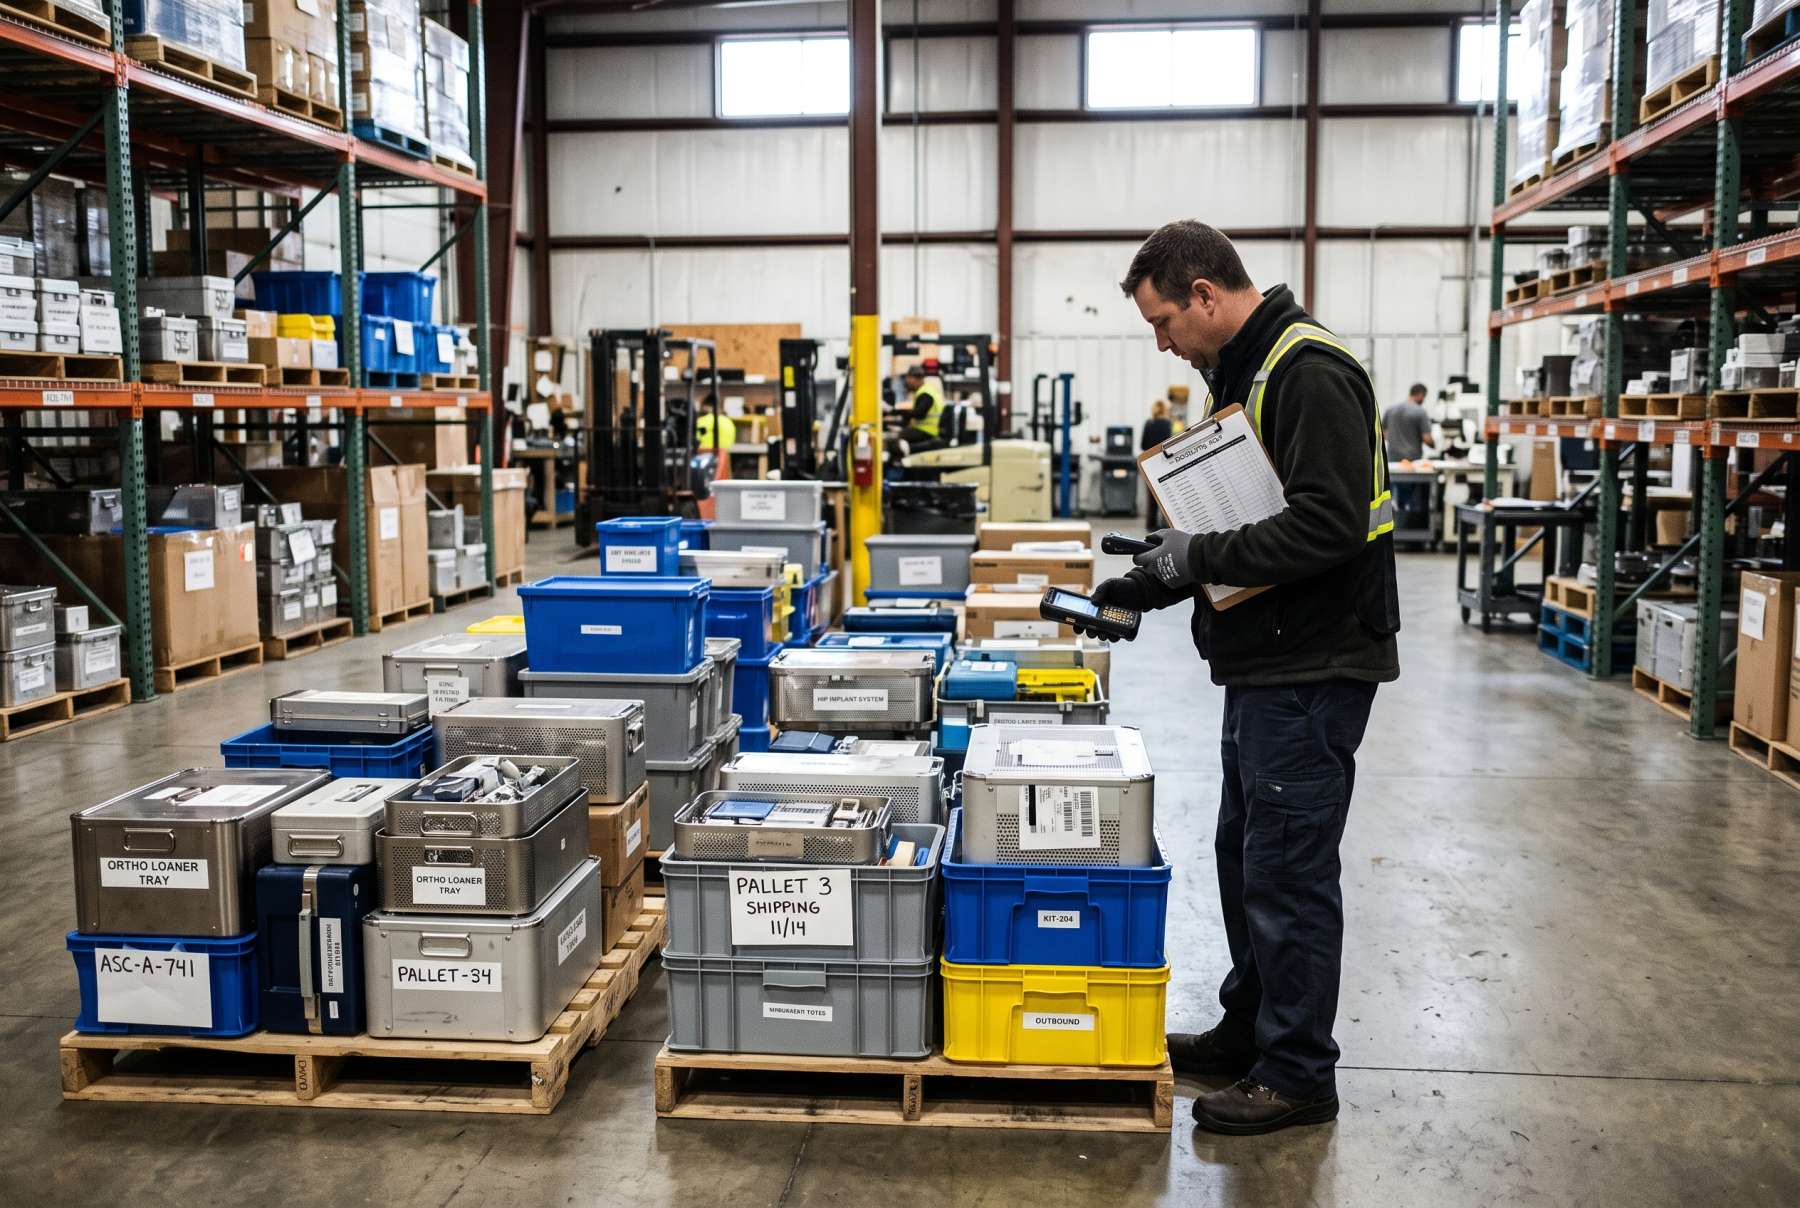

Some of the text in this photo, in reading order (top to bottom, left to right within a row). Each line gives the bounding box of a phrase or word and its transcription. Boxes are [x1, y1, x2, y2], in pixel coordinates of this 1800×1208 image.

[107, 860, 199, 872] ORTHO LOANER
[139, 875, 170, 886] TRAY
[416, 875, 483, 885] ORTHO LOANER
[439, 886, 461, 895] TRAY
[736, 876, 832, 896] PALLET 3
[746, 901, 820, 915] SHIPPING
[1043, 915, 1073, 923] KIT-204
[770, 917, 806, 938] 11/14
[100, 954, 194, 978] ASC-A-741
[1035, 1017, 1080, 1026] OUTBOUND
